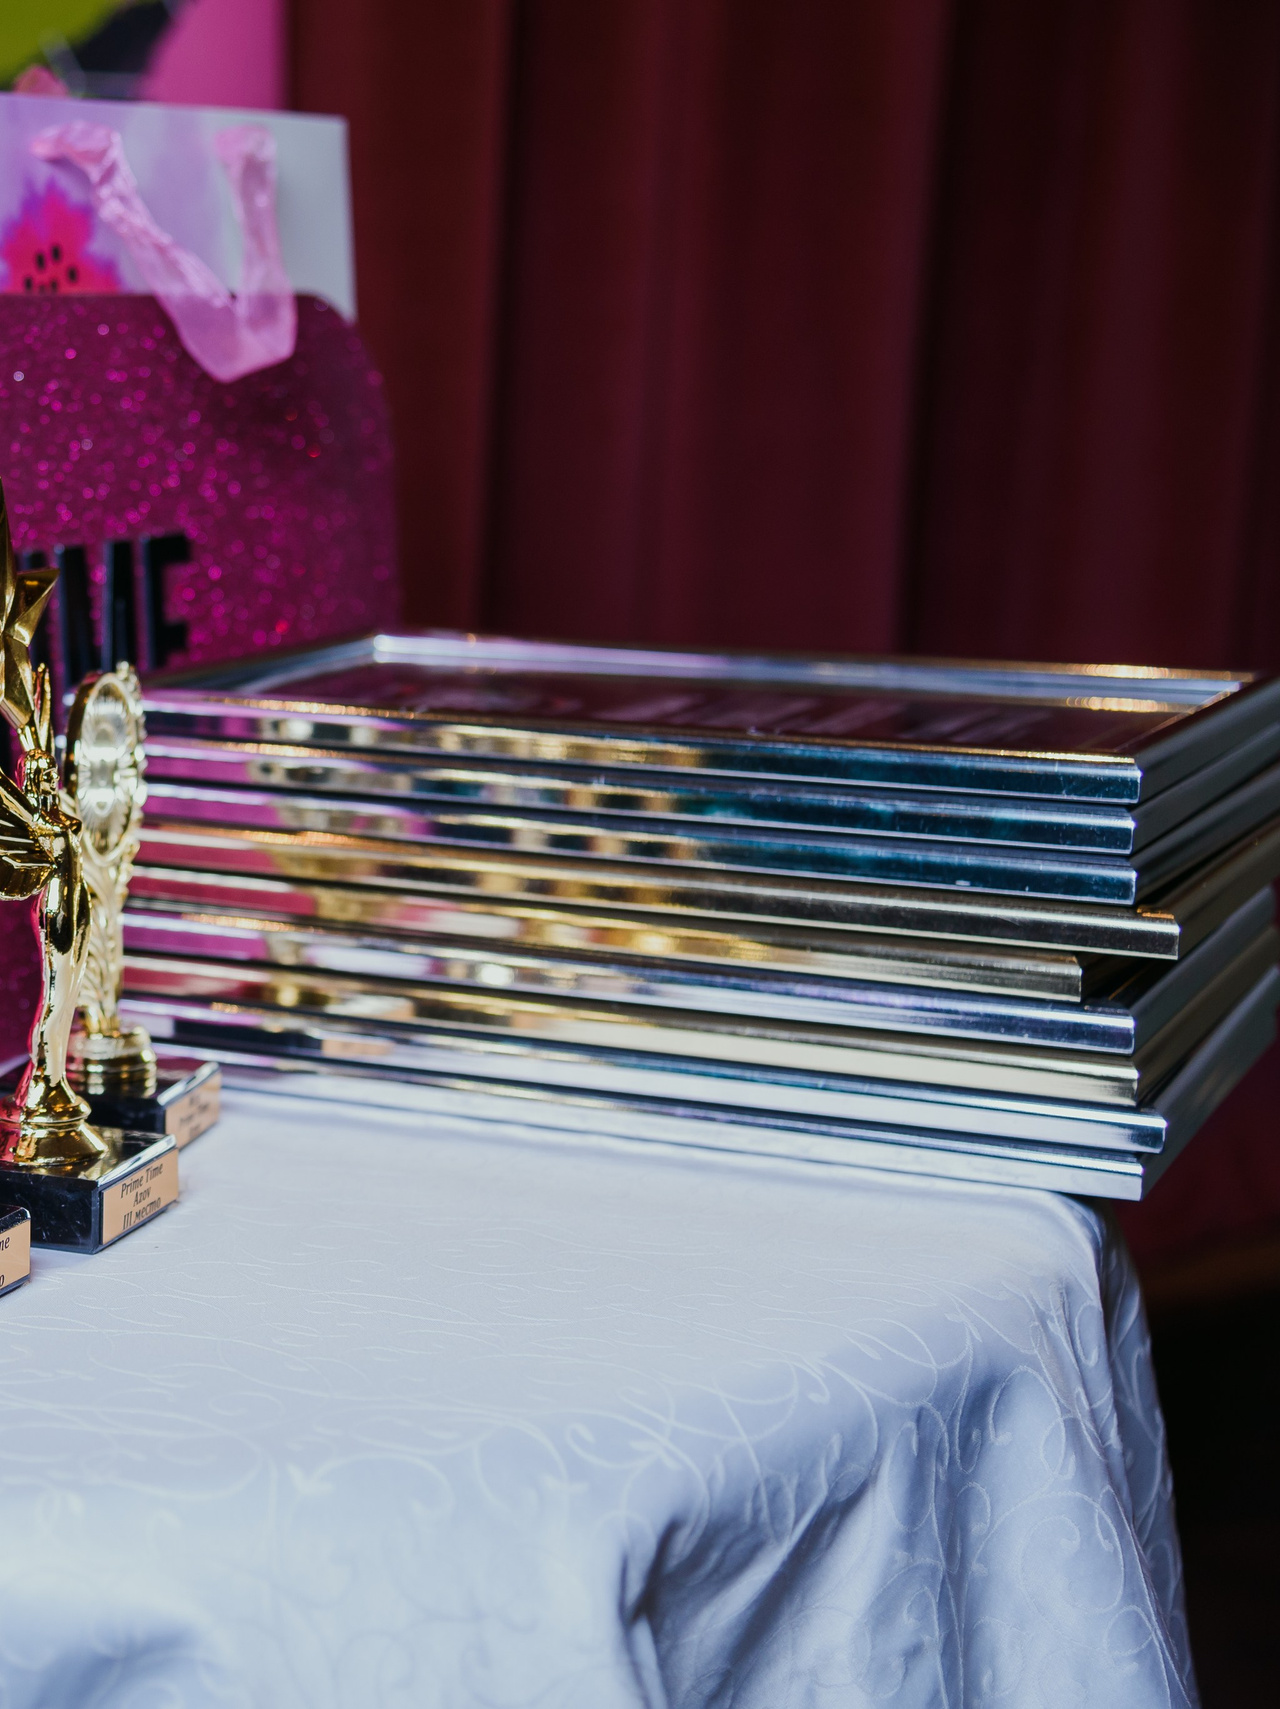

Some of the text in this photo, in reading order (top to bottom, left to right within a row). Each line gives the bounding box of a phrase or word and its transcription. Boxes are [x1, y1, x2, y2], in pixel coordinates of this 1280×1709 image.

[121, 1163, 163, 1199] Prime Time
[133, 1187, 151, 1207] Azov
